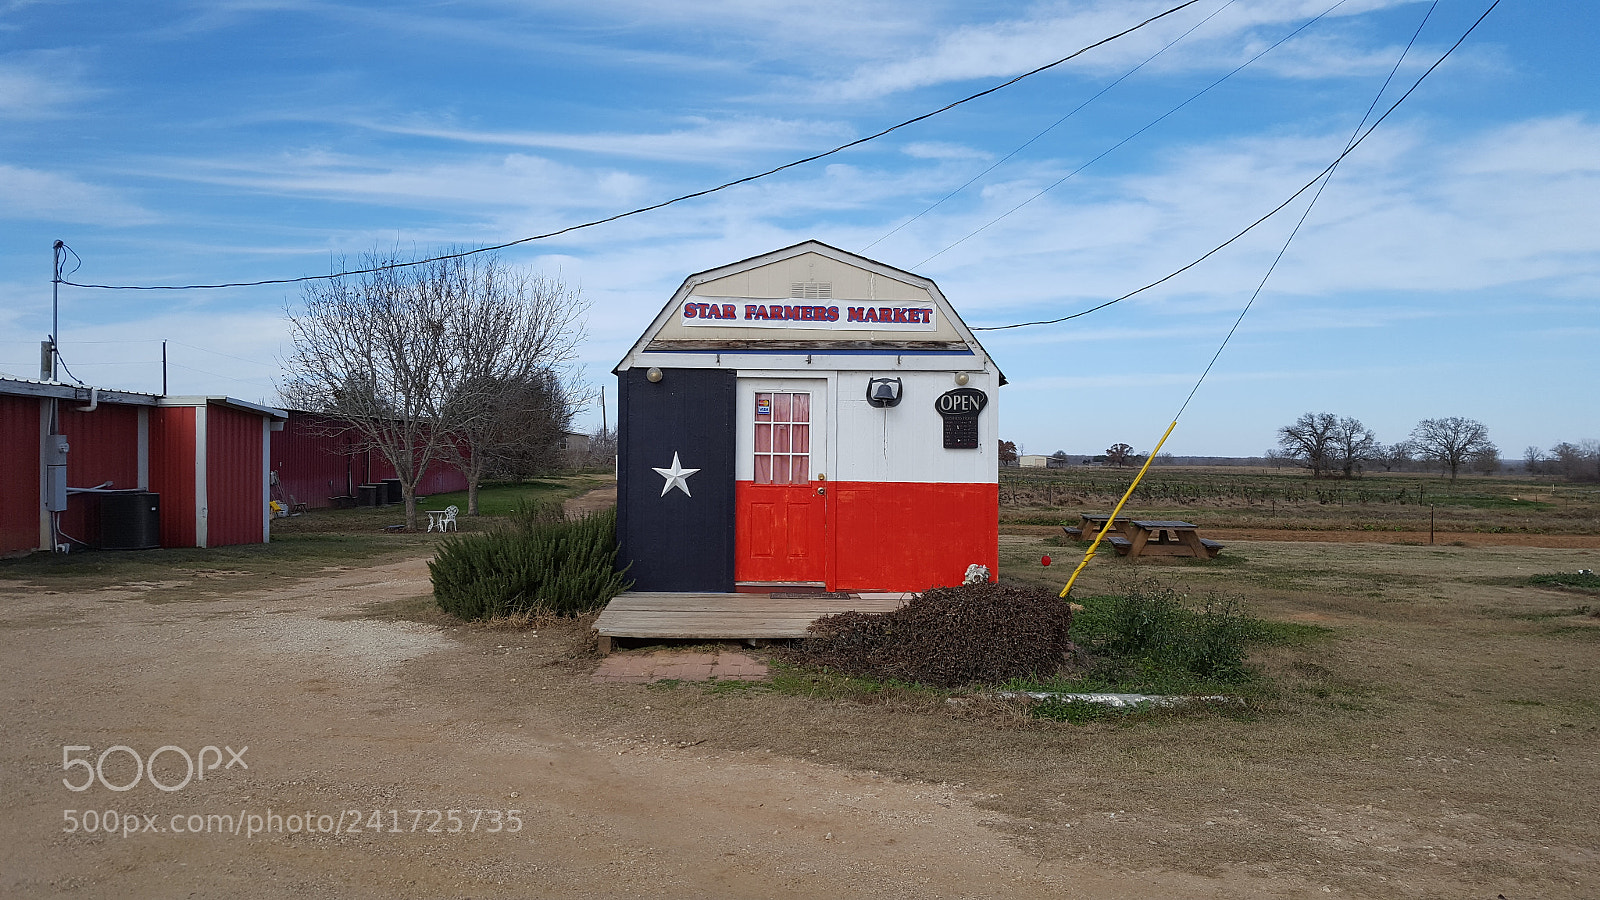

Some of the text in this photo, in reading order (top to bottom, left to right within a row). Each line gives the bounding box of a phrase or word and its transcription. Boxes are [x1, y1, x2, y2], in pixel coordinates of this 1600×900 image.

[684, 303, 933, 324] STAR FARMERS MARKET
[940, 395, 980, 411] OPEN
